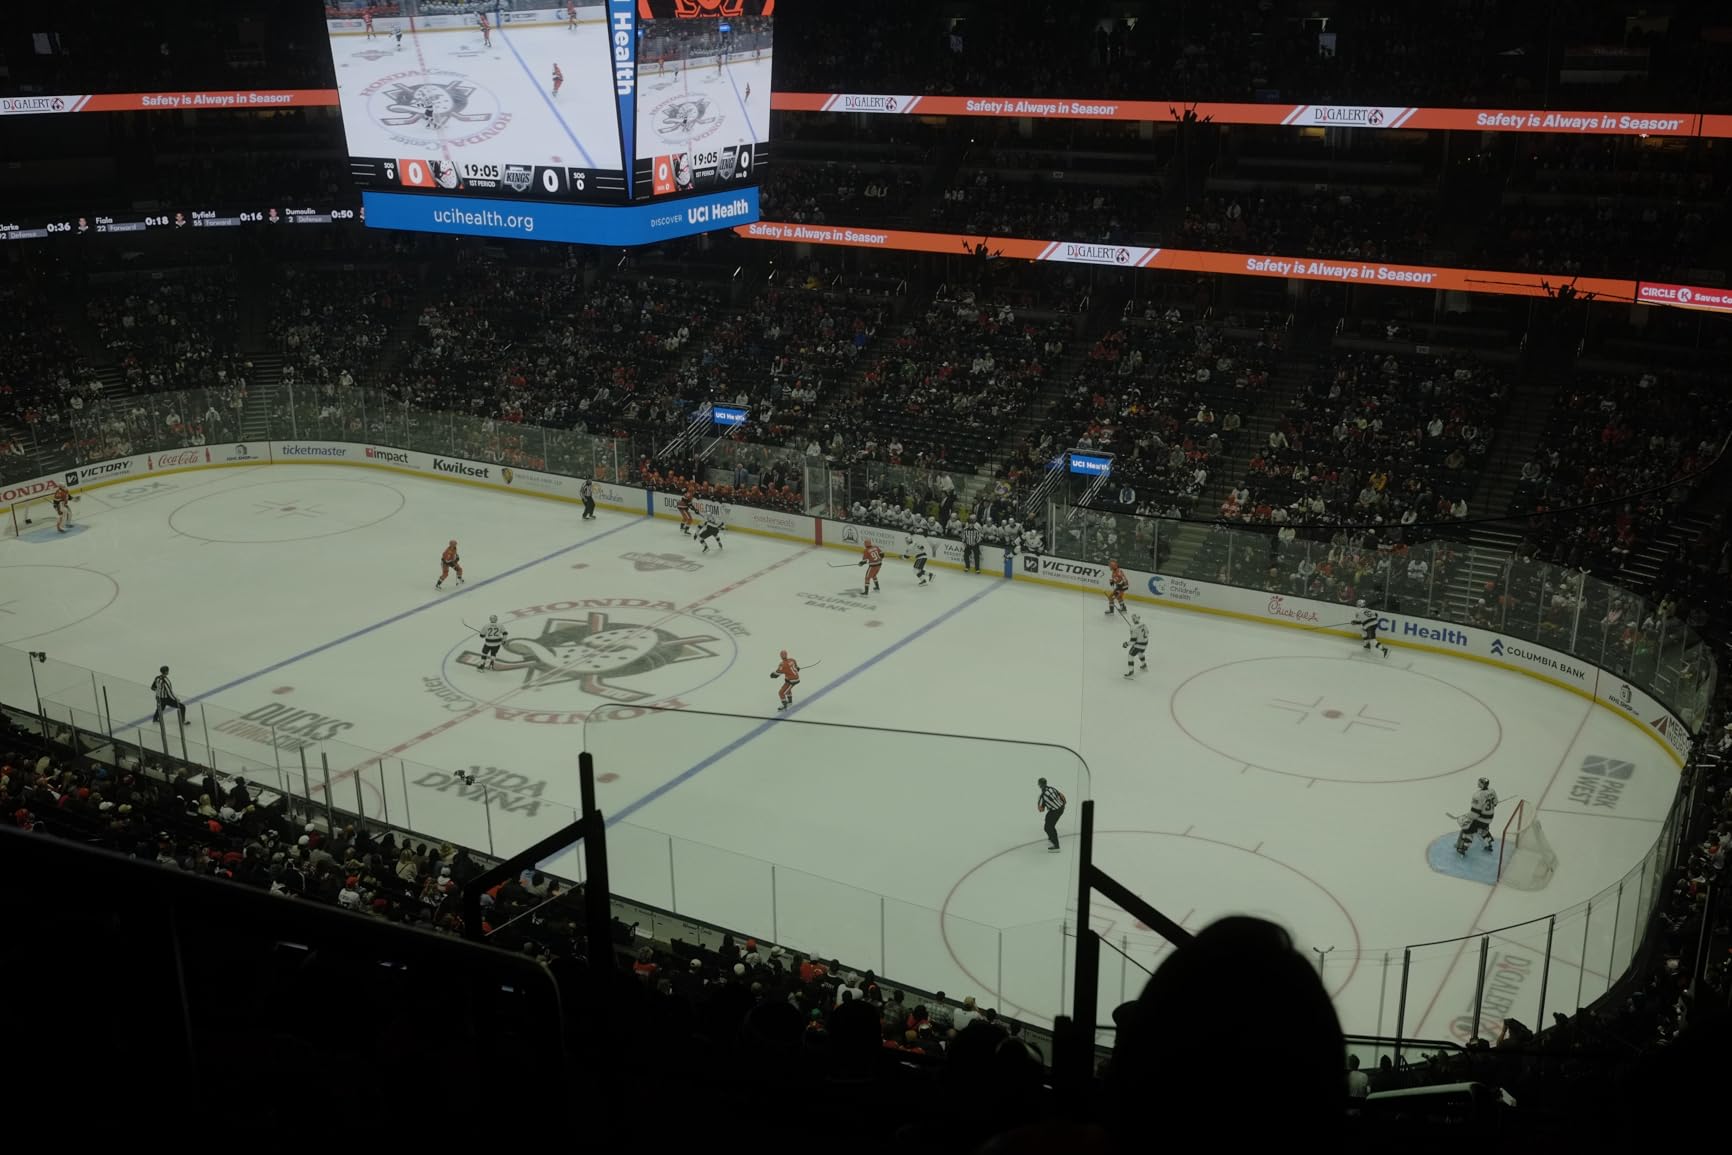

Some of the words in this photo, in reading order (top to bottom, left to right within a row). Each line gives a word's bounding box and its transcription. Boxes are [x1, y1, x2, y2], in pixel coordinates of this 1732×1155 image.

[613, 12, 634, 95] Health
[3, 98, 50, 110] DIGALERT
[142, 95, 179, 107] Safety
[182, 95, 192, 105] is
[194, 94, 234, 107] Always
[237, 93, 247, 104] in
[249, 93, 290, 104] Season
[845, 96, 885, 108] DIGALERT
[966, 100, 1003, 113] Safety
[1004, 101, 1014, 112] is
[1015, 102, 1056, 115] Always
[1058, 103, 1069, 113] in
[1071, 103, 1114, 115] Season
[1315, 107, 1368, 121] DIGALERT
[1476, 112, 1527, 128] Safety
[1528, 113, 1540, 127] is
[1542, 114, 1598, 131] Always
[1599, 115, 1616, 129] in
[1619, 116, 1679, 131] Season
[693, 151, 718, 166] 19:05
[741, 151, 749, 169] 0
[386, 169, 394, 180] 0
[408, 161, 423, 185] 0
[464, 163, 499, 178] 19:05
[506, 171, 530, 184] KINGS
[659, 163, 668, 181] 0
[469, 179, 480, 187] 1ST
[481, 180, 496, 188] PERIOD
[543, 169, 559, 193] 0
[576, 179, 585, 190] 0
[95, 216, 113, 224] Fiala
[191, 210, 216, 219] Byfield
[239, 212, 263, 221] 0:16
[285, 208, 316, 216] Dumoulin
[331, 209, 354, 219] 0:50
[433, 208, 534, 232] ucihealth.org
[650, 214, 683, 228] DISCOVER
[687, 206, 708, 224] UCI
[711, 198, 749, 219] Health
[47, 223, 71, 232] 0:36
[145, 216, 169, 226] 0:18
[749, 224, 782, 237] Safety
[783, 226, 792, 237] is
[794, 227, 831, 240] Always
[833, 229, 843, 241] in
[844, 231, 884, 244] Season
[1067, 245, 1115, 259] DIGALERT
[1246, 258, 1291, 275] Safety
[1293, 261, 1305, 274] is
[1307, 263, 1359, 279] Always
[1361, 266, 1375, 280] in
[1377, 267, 1432, 283] Season
[1641, 286, 1676, 299] CIRCLE
[1695, 293, 1720, 303] Saves
[282, 445, 347, 457] ticketmaster
[374, 447, 409, 463] impact
[80, 461, 130, 478] VICTORY
[433, 458, 489, 479] Kwikset
[1072, 460, 1085, 468] UCI
[0, 480, 58, 502] ONDA
[1042, 560, 1102, 577] VICTORY
[1170, 578, 1186, 588] Rady
[510, 598, 676, 619] HONDA
[691, 606, 753, 638] Center
[487, 627, 500, 637] 22
[1377, 617, 1396, 633] CI
[1403, 622, 1468, 647] Health
[1507, 646, 1558, 670] COLUMBIA
[1560, 663, 1585, 680] BANK
[422, 676, 477, 712] Center
[495, 698, 690, 725] HONDA
[240, 702, 354, 741] DUCKS
[1568, 776, 1600, 805] WEST
[1592, 779, 1625, 809] PARK
